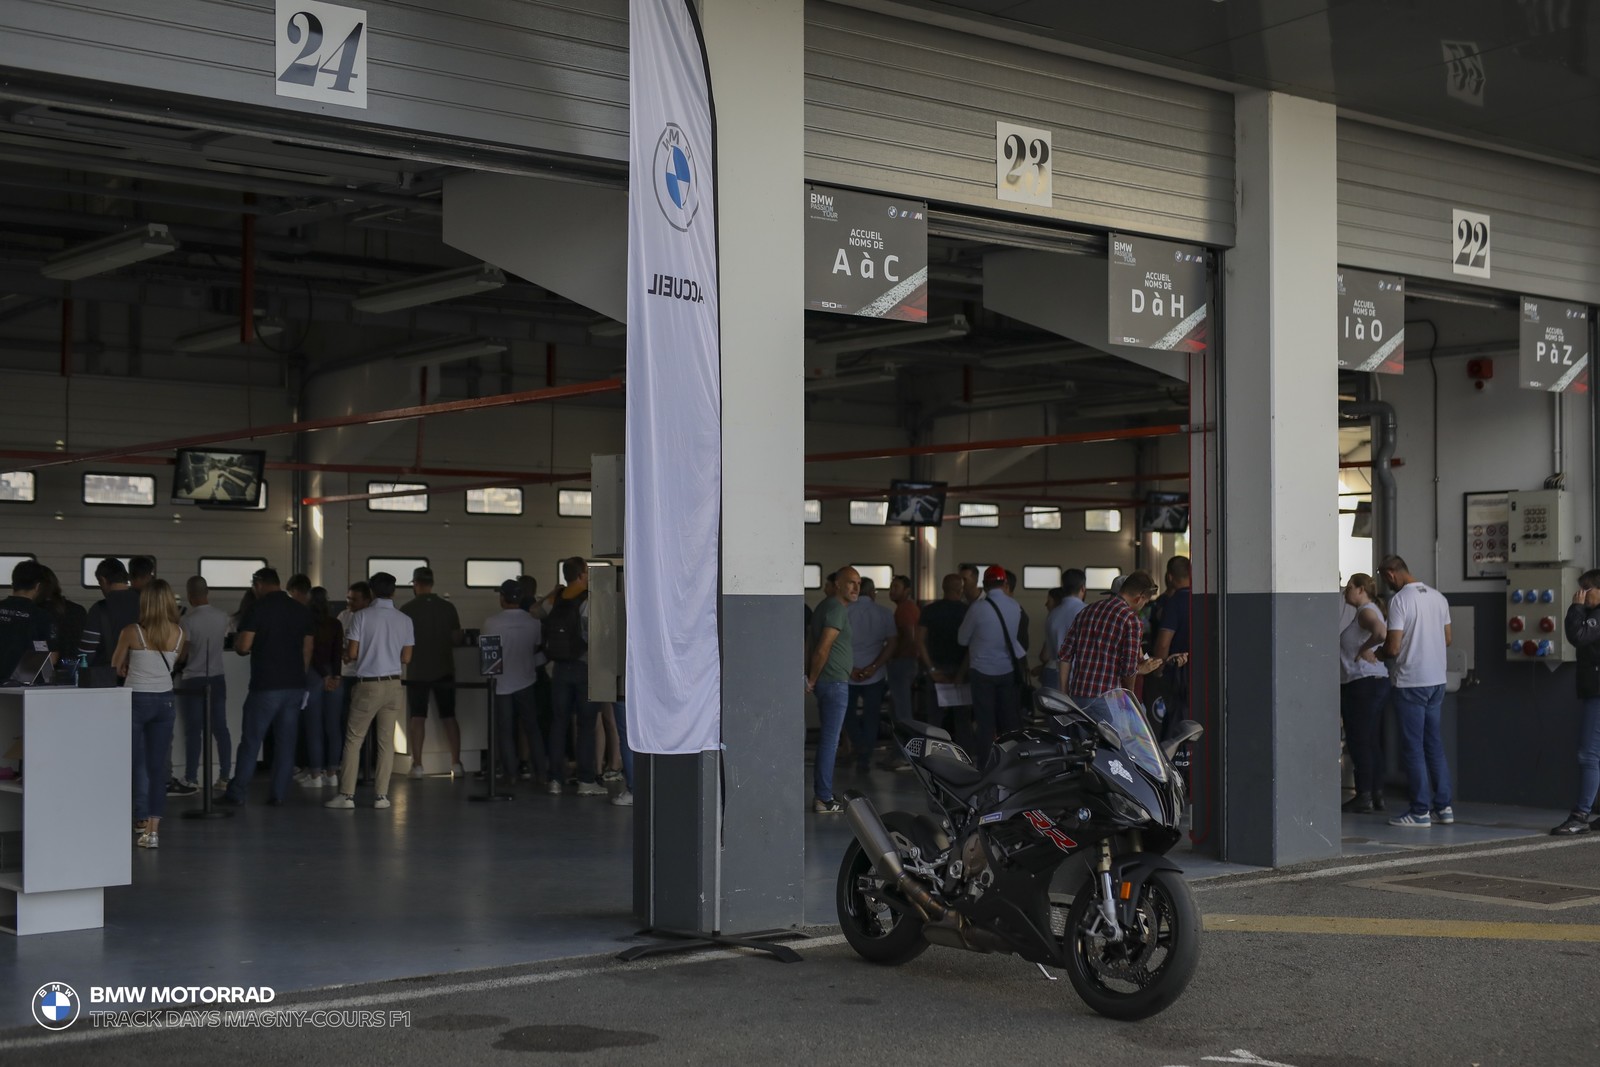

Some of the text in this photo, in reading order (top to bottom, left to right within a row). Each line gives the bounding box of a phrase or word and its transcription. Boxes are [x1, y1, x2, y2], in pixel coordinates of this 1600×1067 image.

[277, 11, 364, 94] 24
[810, 193, 834, 206] BMW
[850, 228, 883, 241] ACCUEIL
[849, 237, 884, 250] NOMS DE
[1114, 241, 1133, 252] BMW
[1454, 218, 1488, 270] 22
[832, 248, 899, 282] A à C
[1145, 271, 1171, 282] ACCUEIL
[1144, 279, 1172, 290] NOMS DE
[1131, 288, 1184, 319] D à H
[1353, 299, 1375, 309] ACCUEIL
[1352, 306, 1376, 317] NOMS DE
[1355, 317, 1365, 340] à
[1370, 319, 1383, 342] O
[1536, 341, 1573, 366] P à Z
